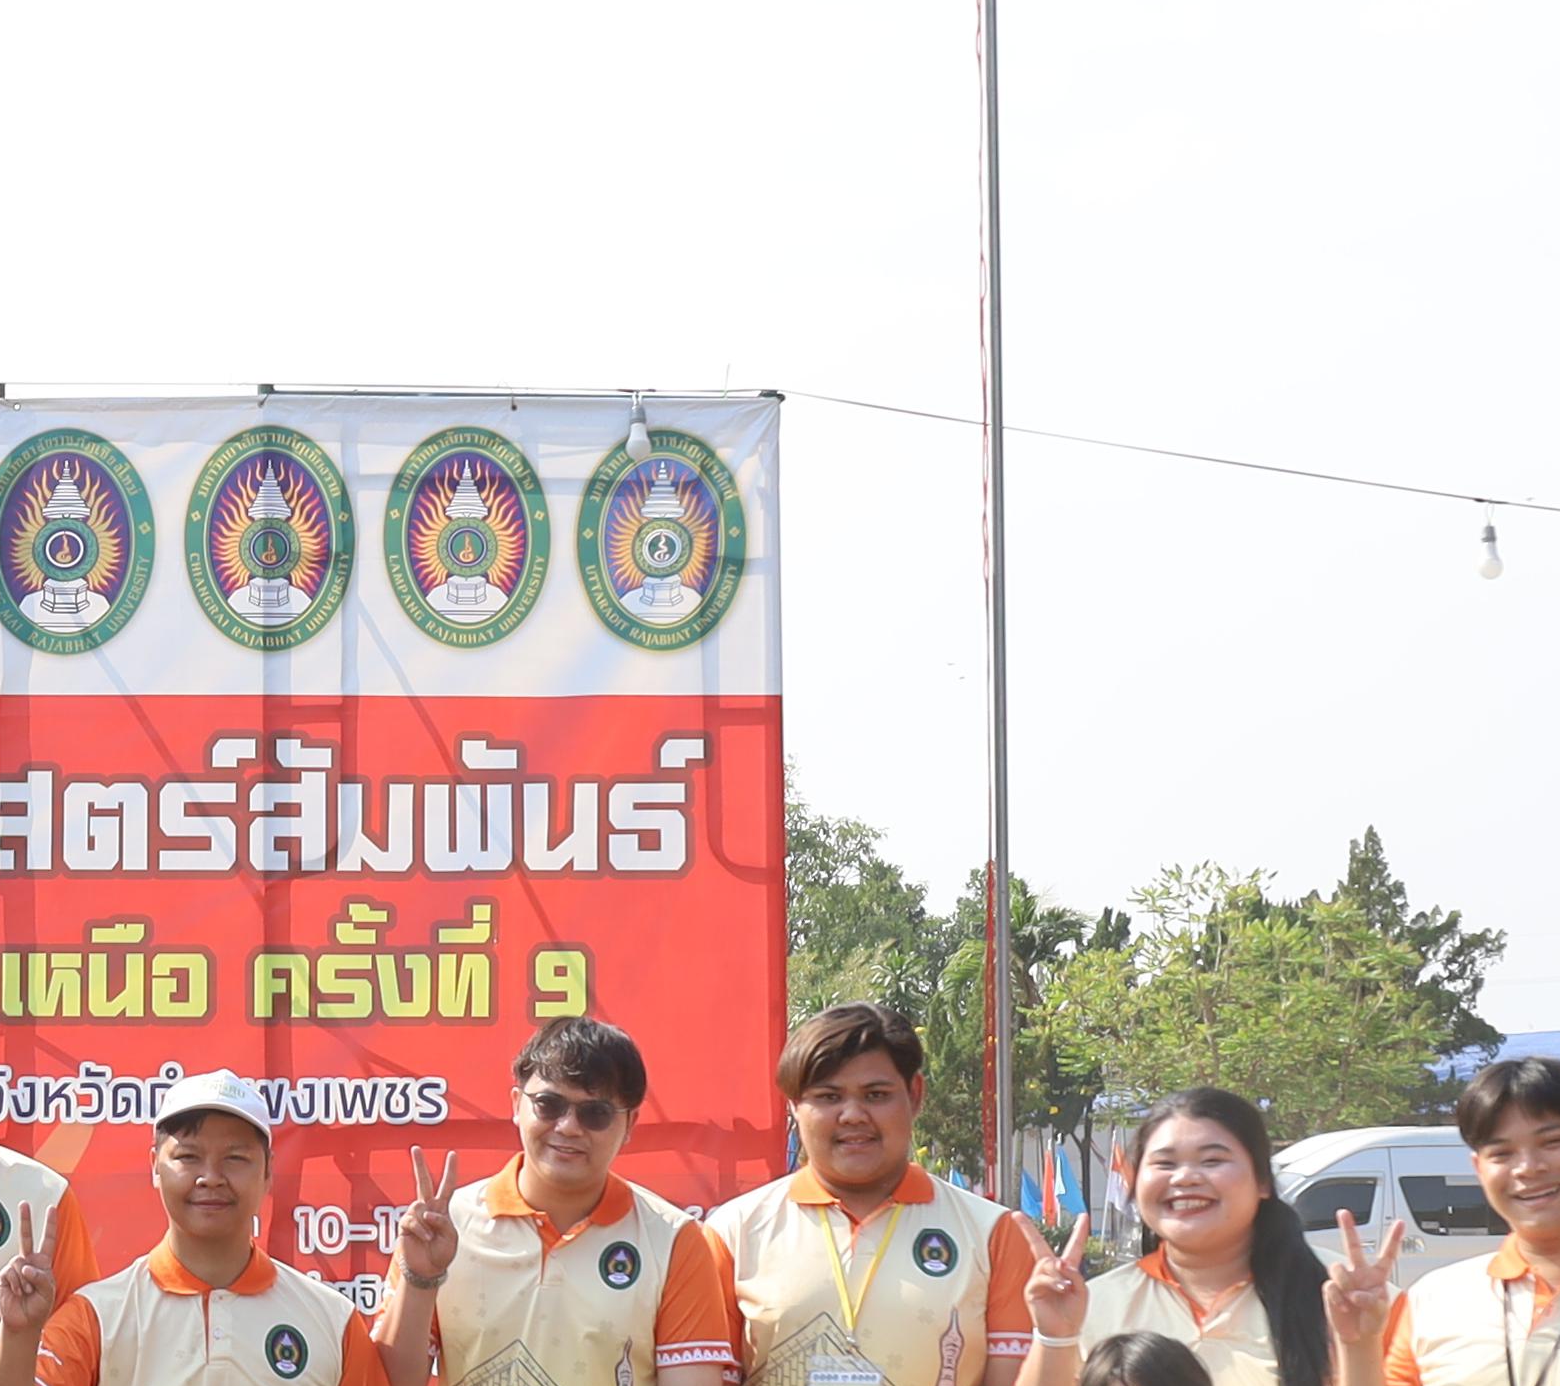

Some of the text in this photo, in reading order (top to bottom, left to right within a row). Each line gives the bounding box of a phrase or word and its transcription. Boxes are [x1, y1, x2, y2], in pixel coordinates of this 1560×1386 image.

[1, 607, 23, 633] MAI
[27, 630, 104, 655] RAJABHAT
[109, 556, 152, 632] UNIVERSITY
[189, 551, 351, 650] CHIANGRAI RAJABHAT UNIVERSITY
[388, 555, 546, 645] LAMPANG RAJABHAT UNIVERSITY
[585, 563, 738, 646] UTTARADIT RAJABHAT UNIVERSITY
[253, 903, 493, 1018] ครั้งที่
[534, 949, 590, 1017] 9
